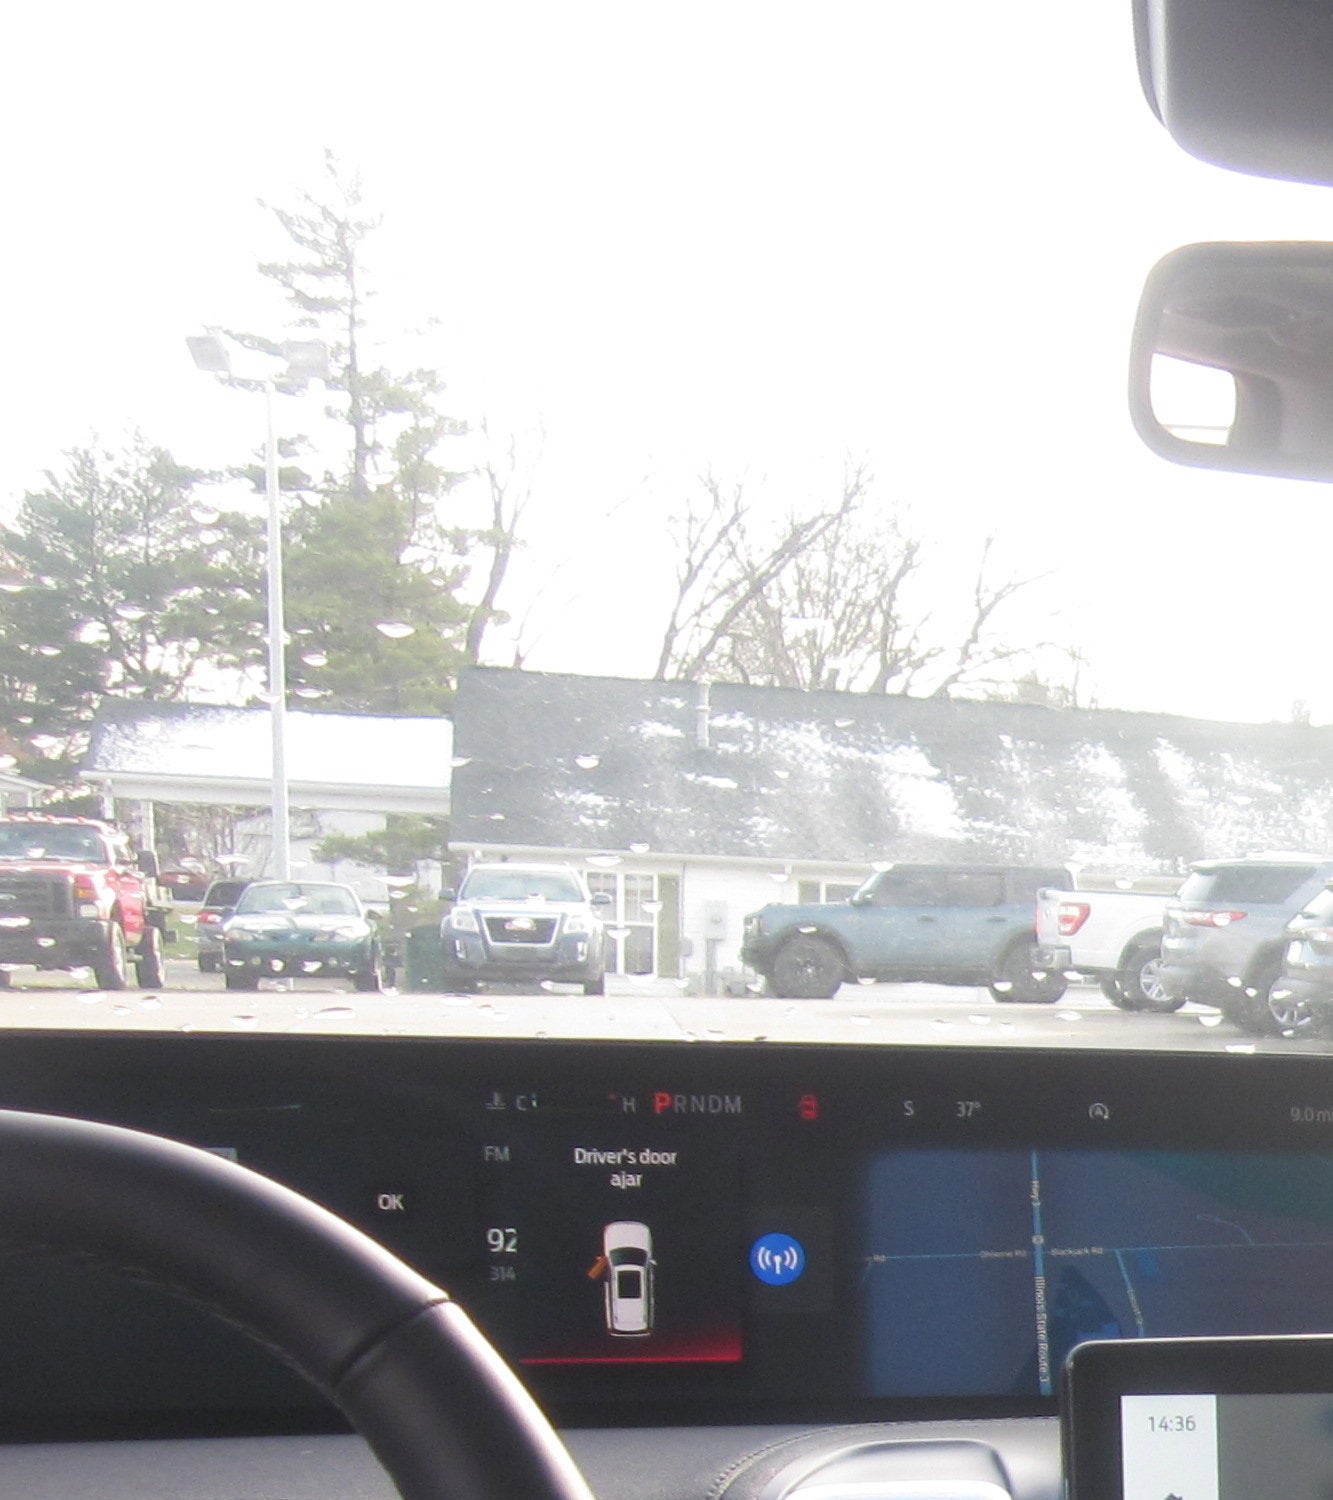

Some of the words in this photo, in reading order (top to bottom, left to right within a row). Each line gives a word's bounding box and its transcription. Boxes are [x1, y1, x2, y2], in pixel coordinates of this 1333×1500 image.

[903, 1101, 914, 1117] S
[483, 1145, 510, 1162] FM
[573, 1147, 637, 1165] Driver's
[639, 1148, 678, 1165] door
[610, 1171, 644, 1190] ajar
[377, 1193, 405, 1211] OK
[486, 1227, 518, 1253] 92
[1036, 1312, 1048, 1340] State
[1038, 1342, 1050, 1373] Route
[1147, 1415, 1197, 1433] 14:36
